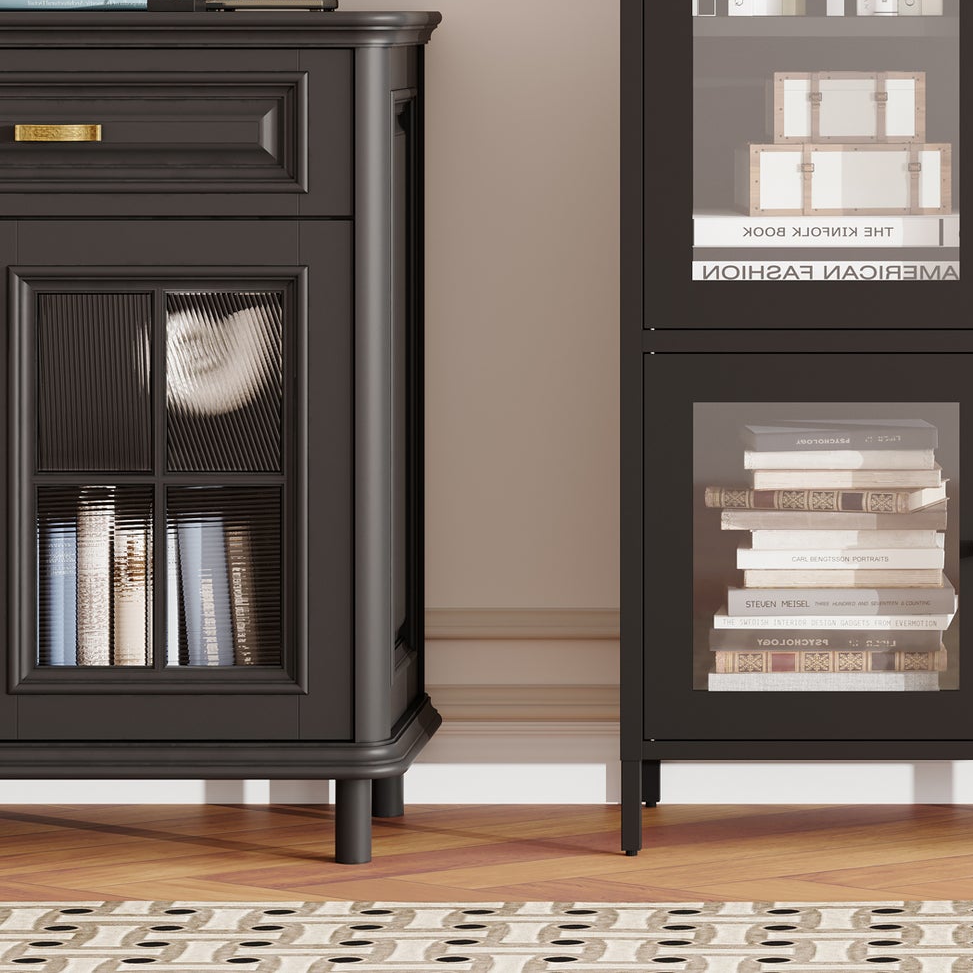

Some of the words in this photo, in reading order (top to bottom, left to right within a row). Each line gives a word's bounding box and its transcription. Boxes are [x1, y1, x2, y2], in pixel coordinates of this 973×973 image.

[796, 437, 851, 445] PSYCHOLOGY
[781, 600, 810, 608] MEISEL
[895, 618, 938, 626] EVERMOTION
